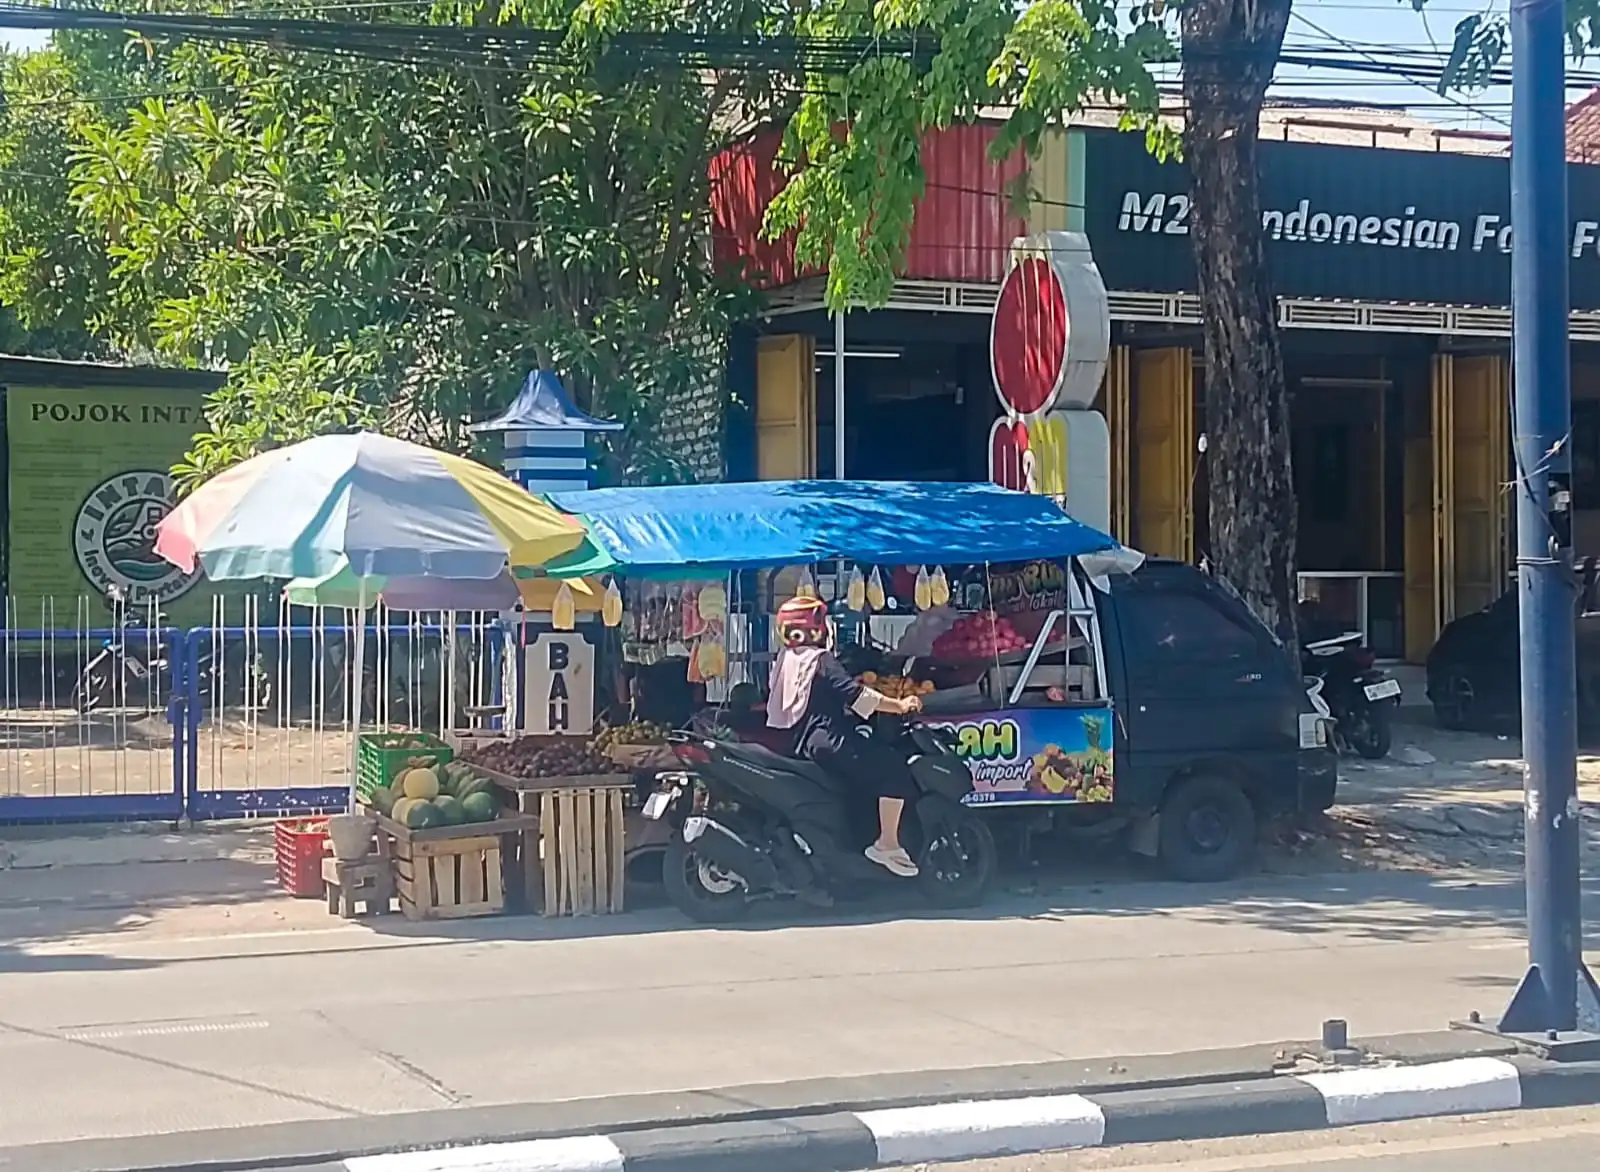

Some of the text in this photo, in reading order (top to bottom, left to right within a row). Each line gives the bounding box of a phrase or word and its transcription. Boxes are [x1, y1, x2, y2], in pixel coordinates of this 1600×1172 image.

[1118, 191, 1190, 235] M2
[1261, 199, 1460, 251] ndonesian
[31, 403, 208, 425] POJOK INTA
[83, 476, 176, 522] INTA
[548, 642, 570, 735] BAH
[956, 723, 1015, 760] AH
[976, 757, 1034, 787] import
